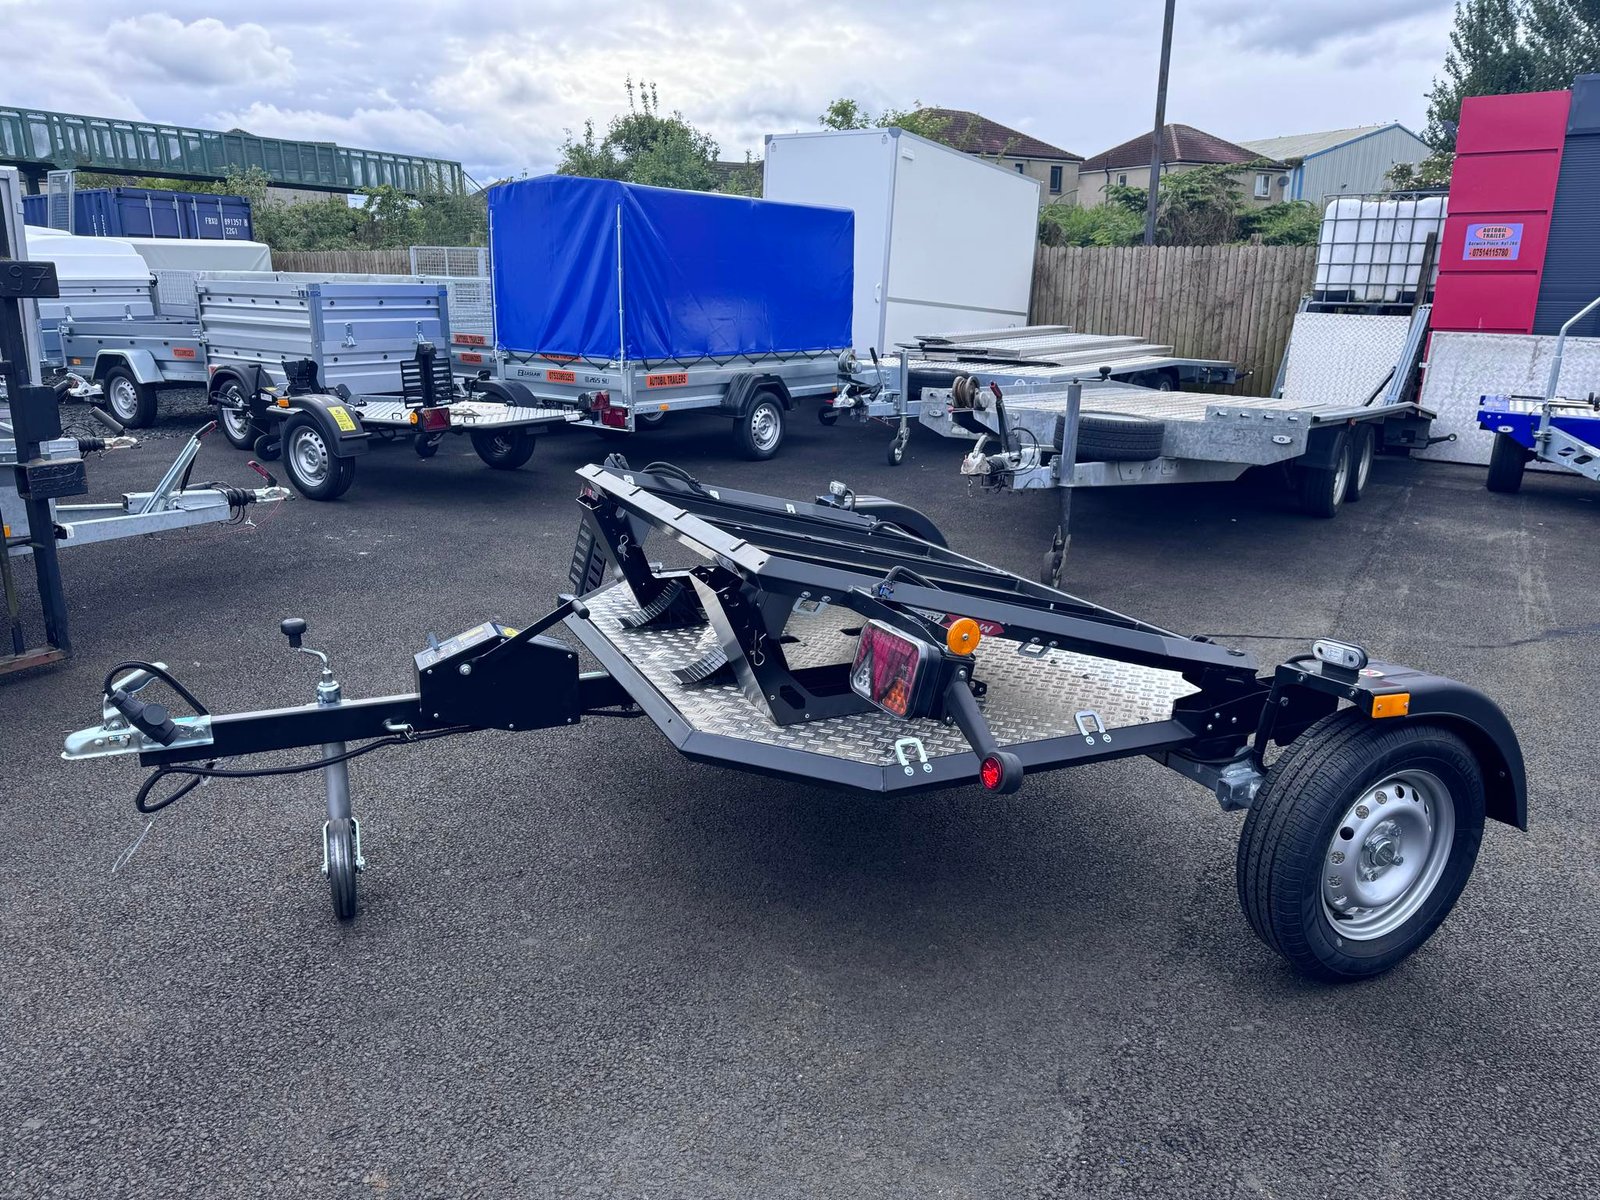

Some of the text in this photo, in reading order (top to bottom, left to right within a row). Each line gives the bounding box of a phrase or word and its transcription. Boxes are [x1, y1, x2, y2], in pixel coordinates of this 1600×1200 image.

[1472, 248, 1509, 257] 07514115780
[649, 374, 686, 387] AUTOBIL TRAILERS
